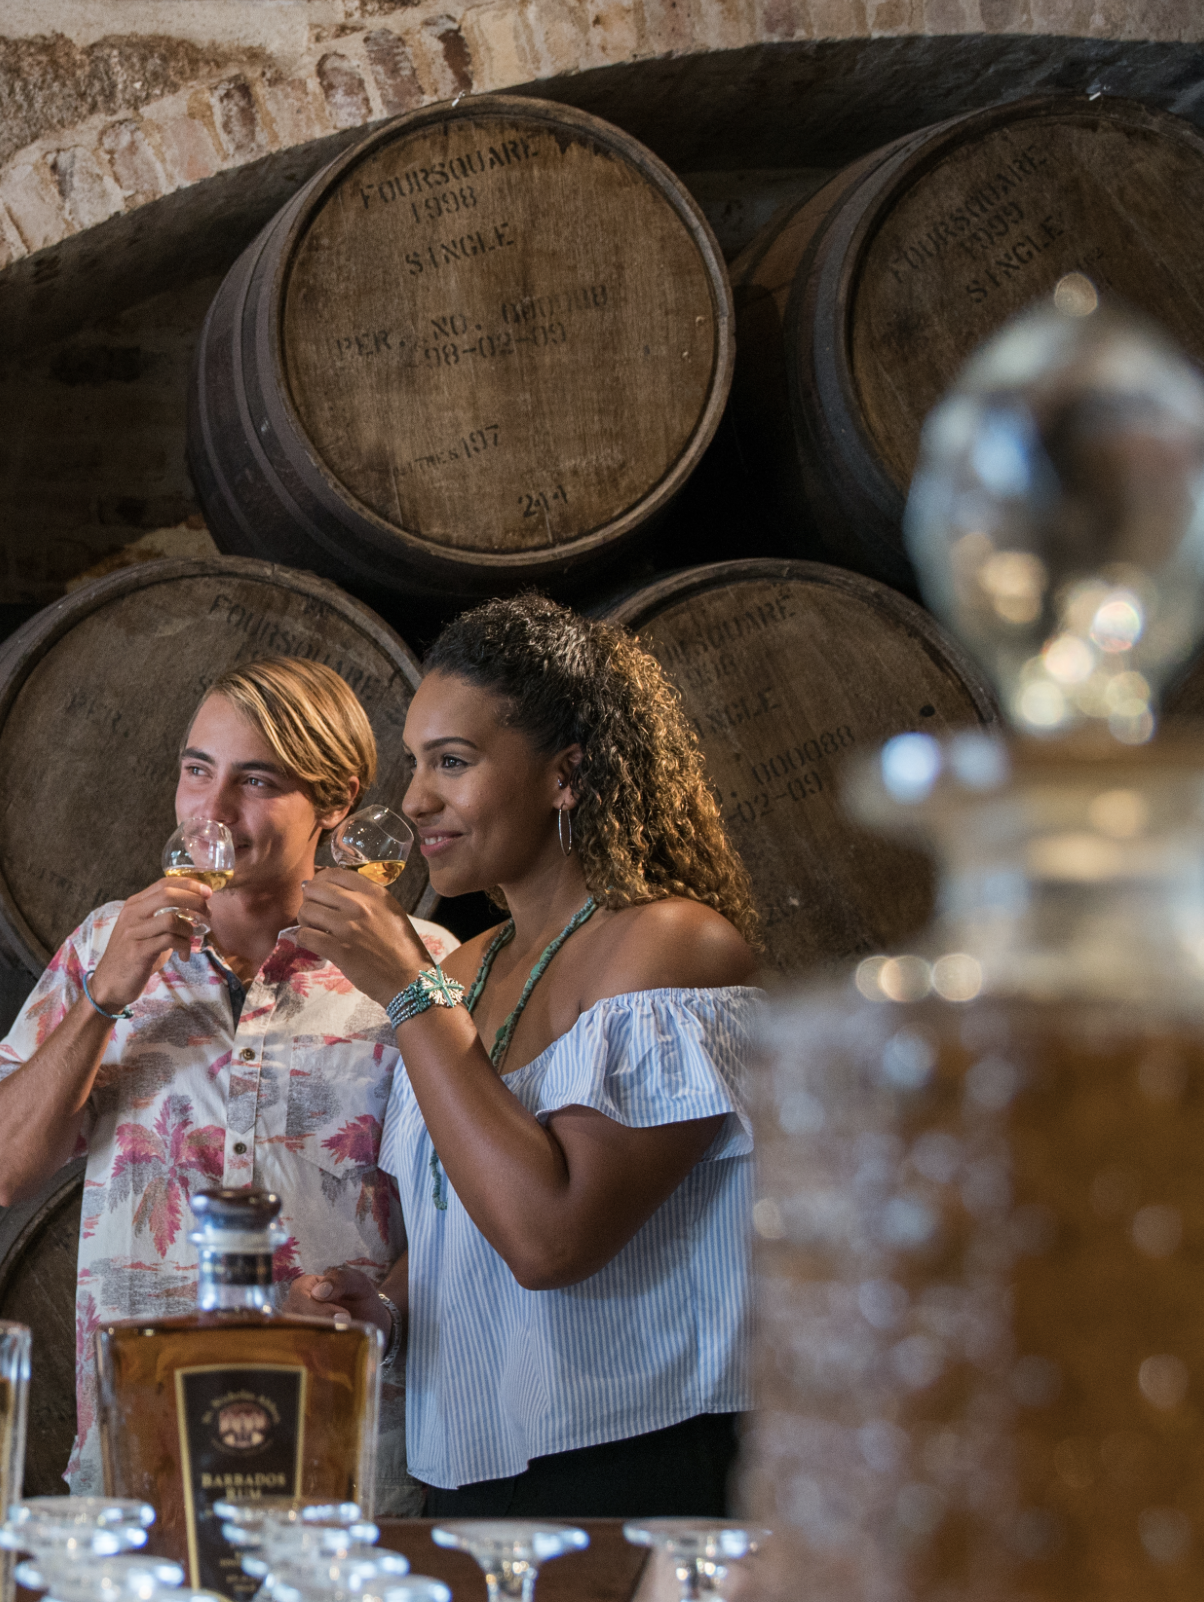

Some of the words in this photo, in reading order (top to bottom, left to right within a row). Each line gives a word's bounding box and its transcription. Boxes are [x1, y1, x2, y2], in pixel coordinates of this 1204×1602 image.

[359, 137, 540, 210] FOURSQUARE
[409, 185, 478, 224] 1998
[404, 221, 516, 276] SINGLE
[965, 211, 1065, 304] SINGLE
[430, 313, 483, 341] NO.
[751, 724, 856, 786] 000088
